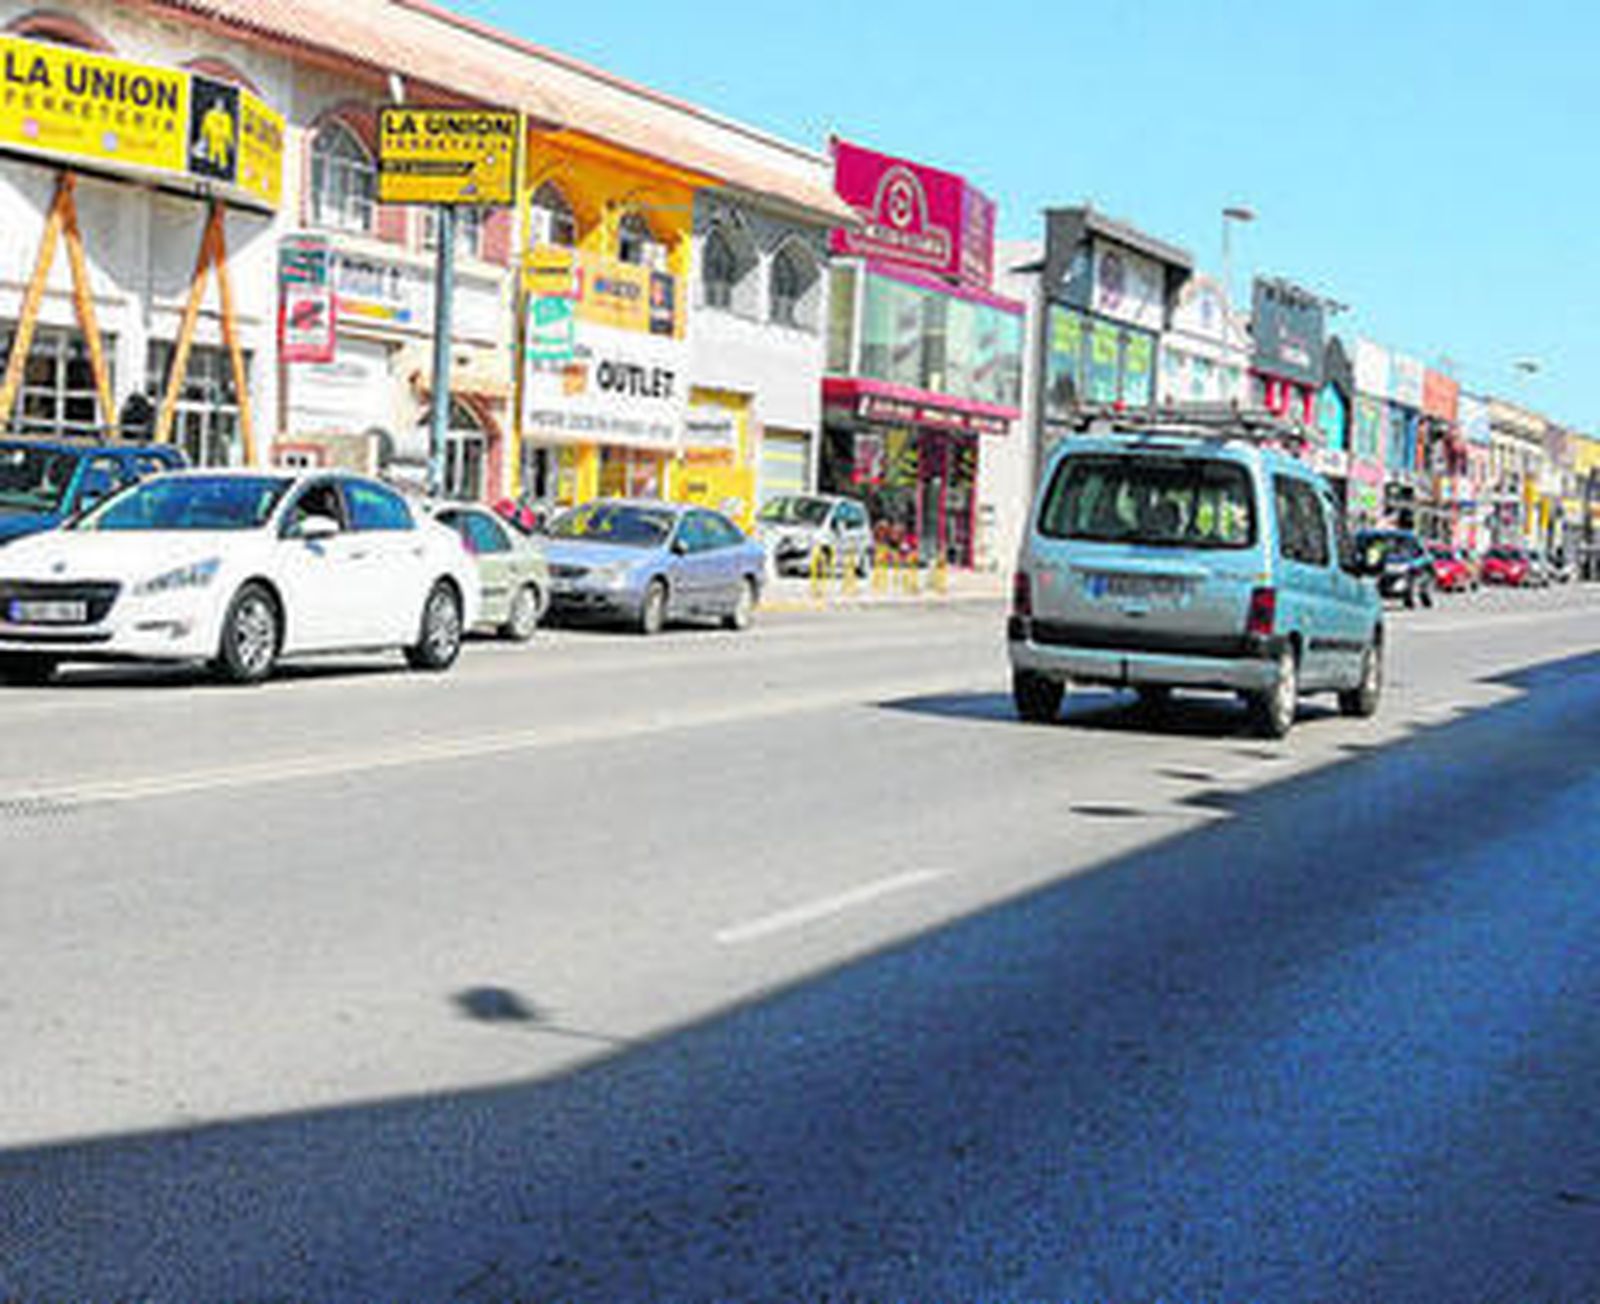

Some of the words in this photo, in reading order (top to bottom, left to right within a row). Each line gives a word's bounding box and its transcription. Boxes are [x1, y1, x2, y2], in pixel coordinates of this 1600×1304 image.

[5, 51, 51, 88] LA
[65, 62, 178, 114] UNION
[386, 114, 417, 135] LA
[424, 116, 512, 137] UNION
[597, 360, 675, 399] OUTLET
